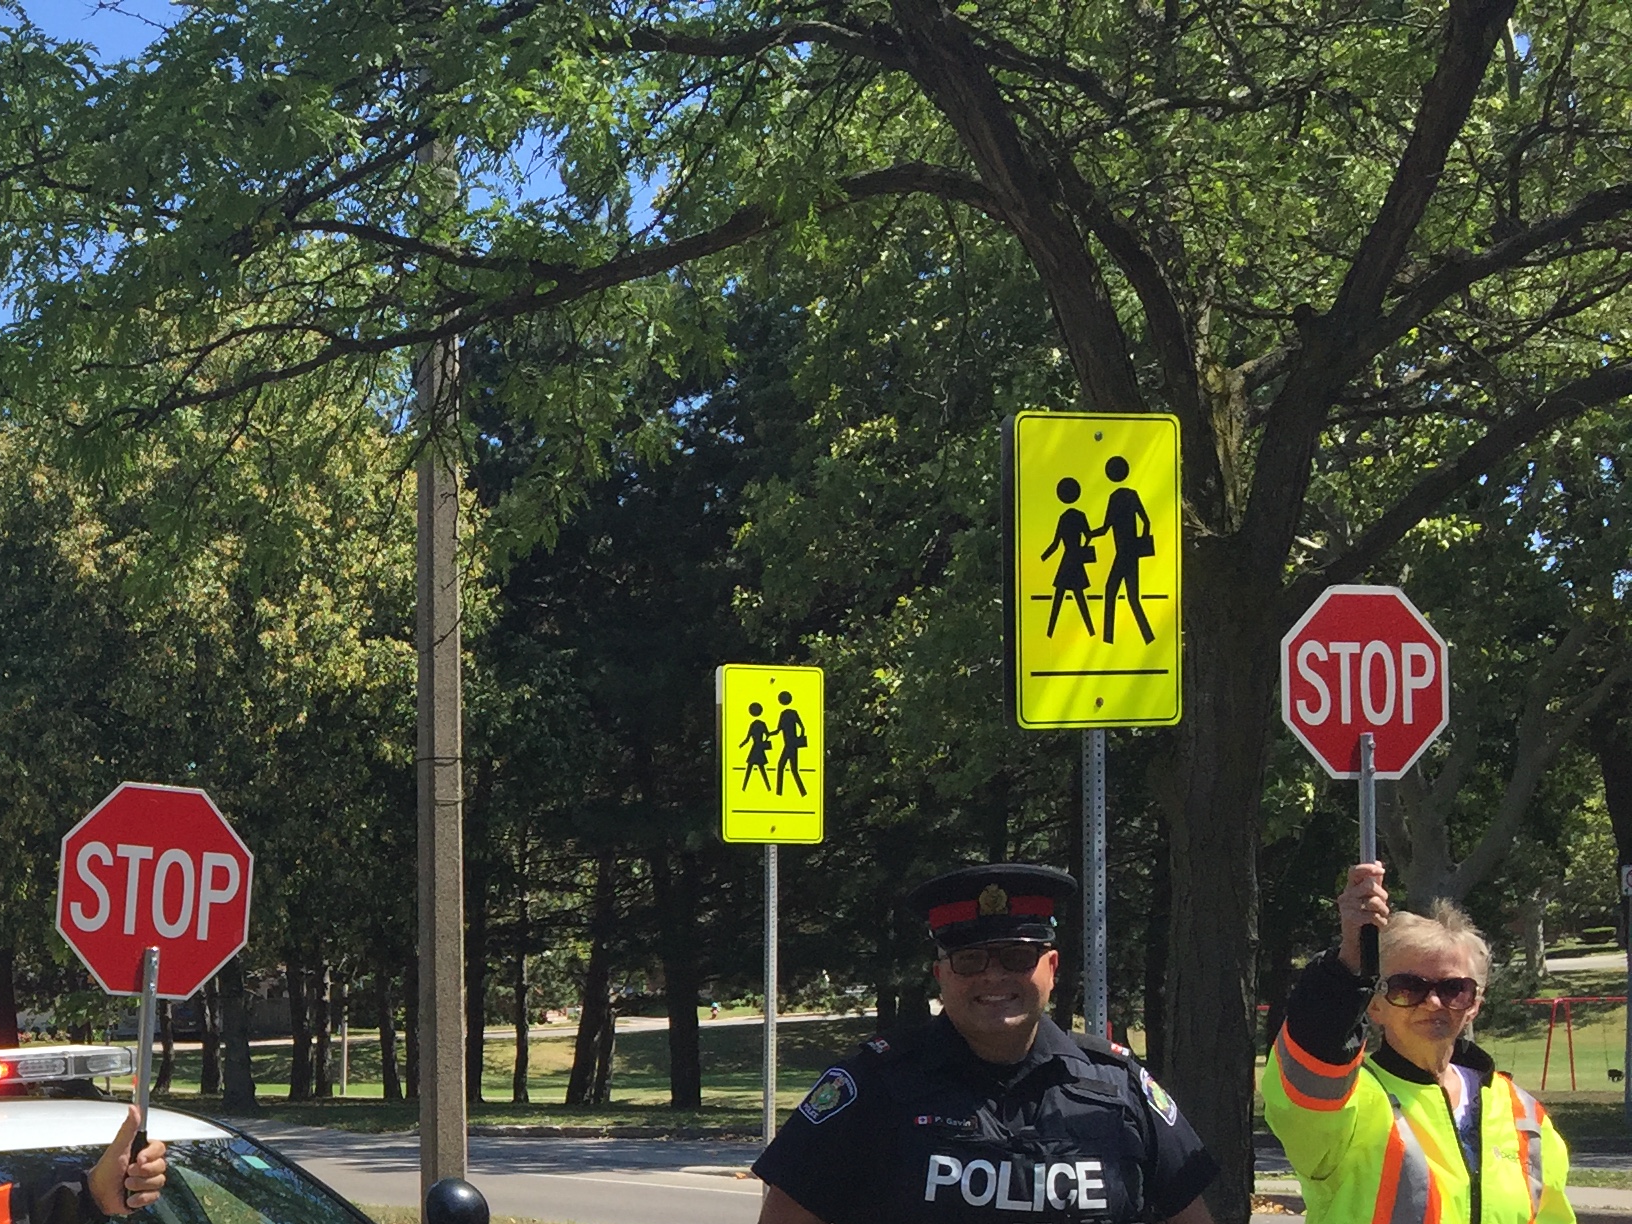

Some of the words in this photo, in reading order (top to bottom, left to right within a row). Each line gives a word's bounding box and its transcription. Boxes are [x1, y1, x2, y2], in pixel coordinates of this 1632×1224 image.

[1296, 640, 1436, 726] STOP
[70, 841, 240, 941] STOP
[924, 1154, 1107, 1212] POLICE
